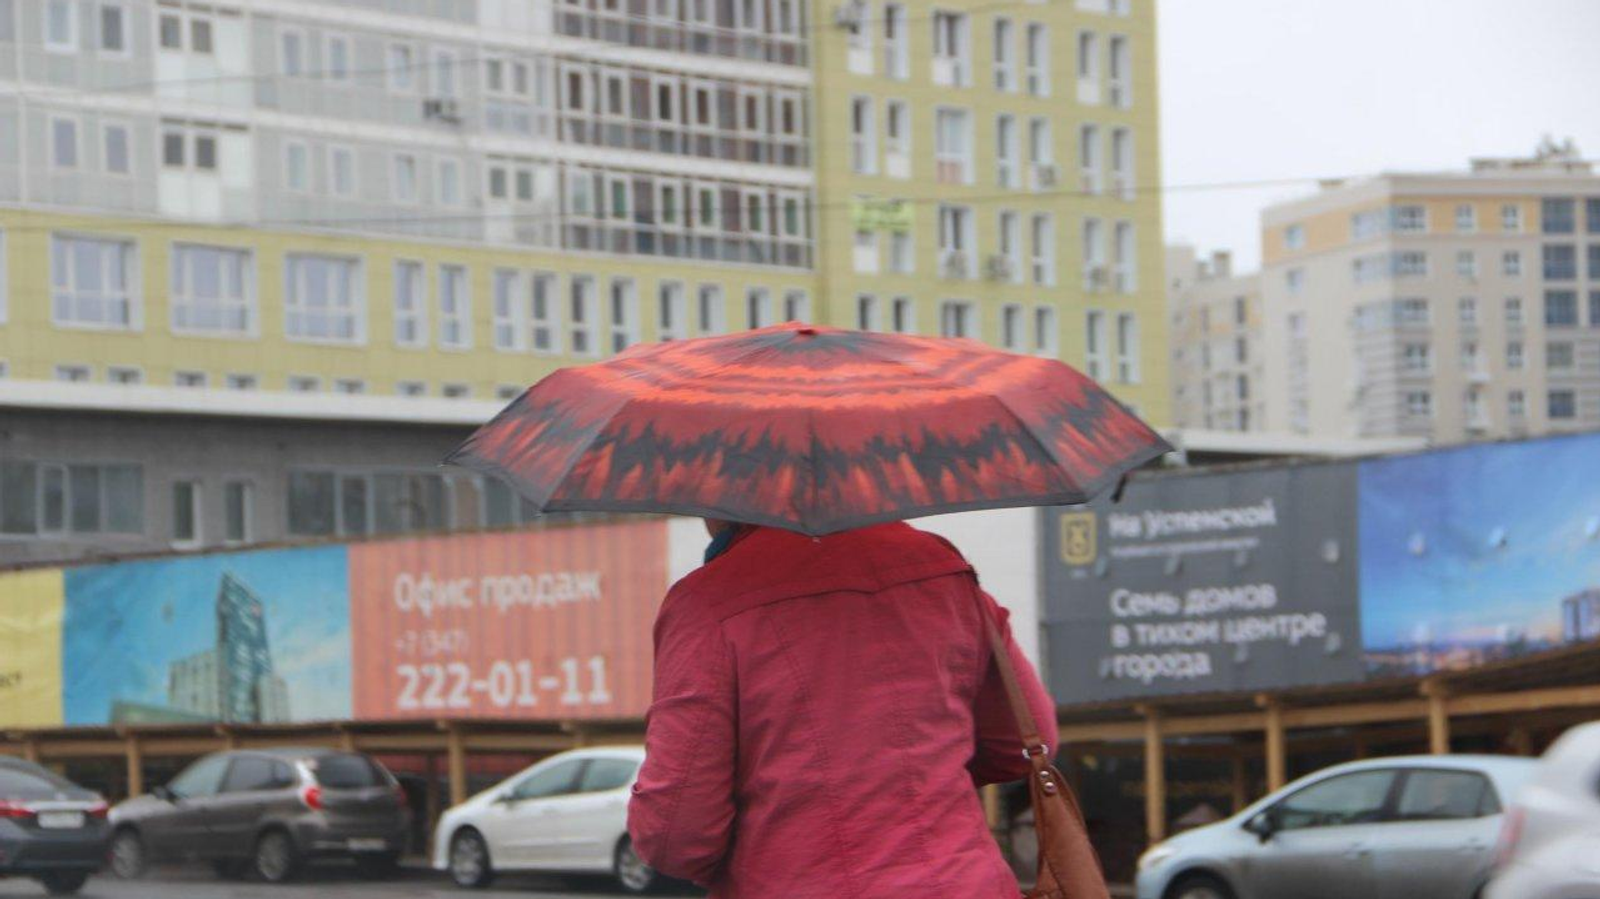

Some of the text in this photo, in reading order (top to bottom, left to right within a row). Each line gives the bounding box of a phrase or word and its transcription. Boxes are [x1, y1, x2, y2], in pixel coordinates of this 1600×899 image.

[394, 571, 601, 618] Офис продаж
[1109, 582, 1277, 618] Семь домов
[1134, 620, 1220, 645] тихом
[1222, 612, 1327, 646] центре
[396, 655, 611, 710] 222-01-11
[1111, 652, 1212, 683] города
